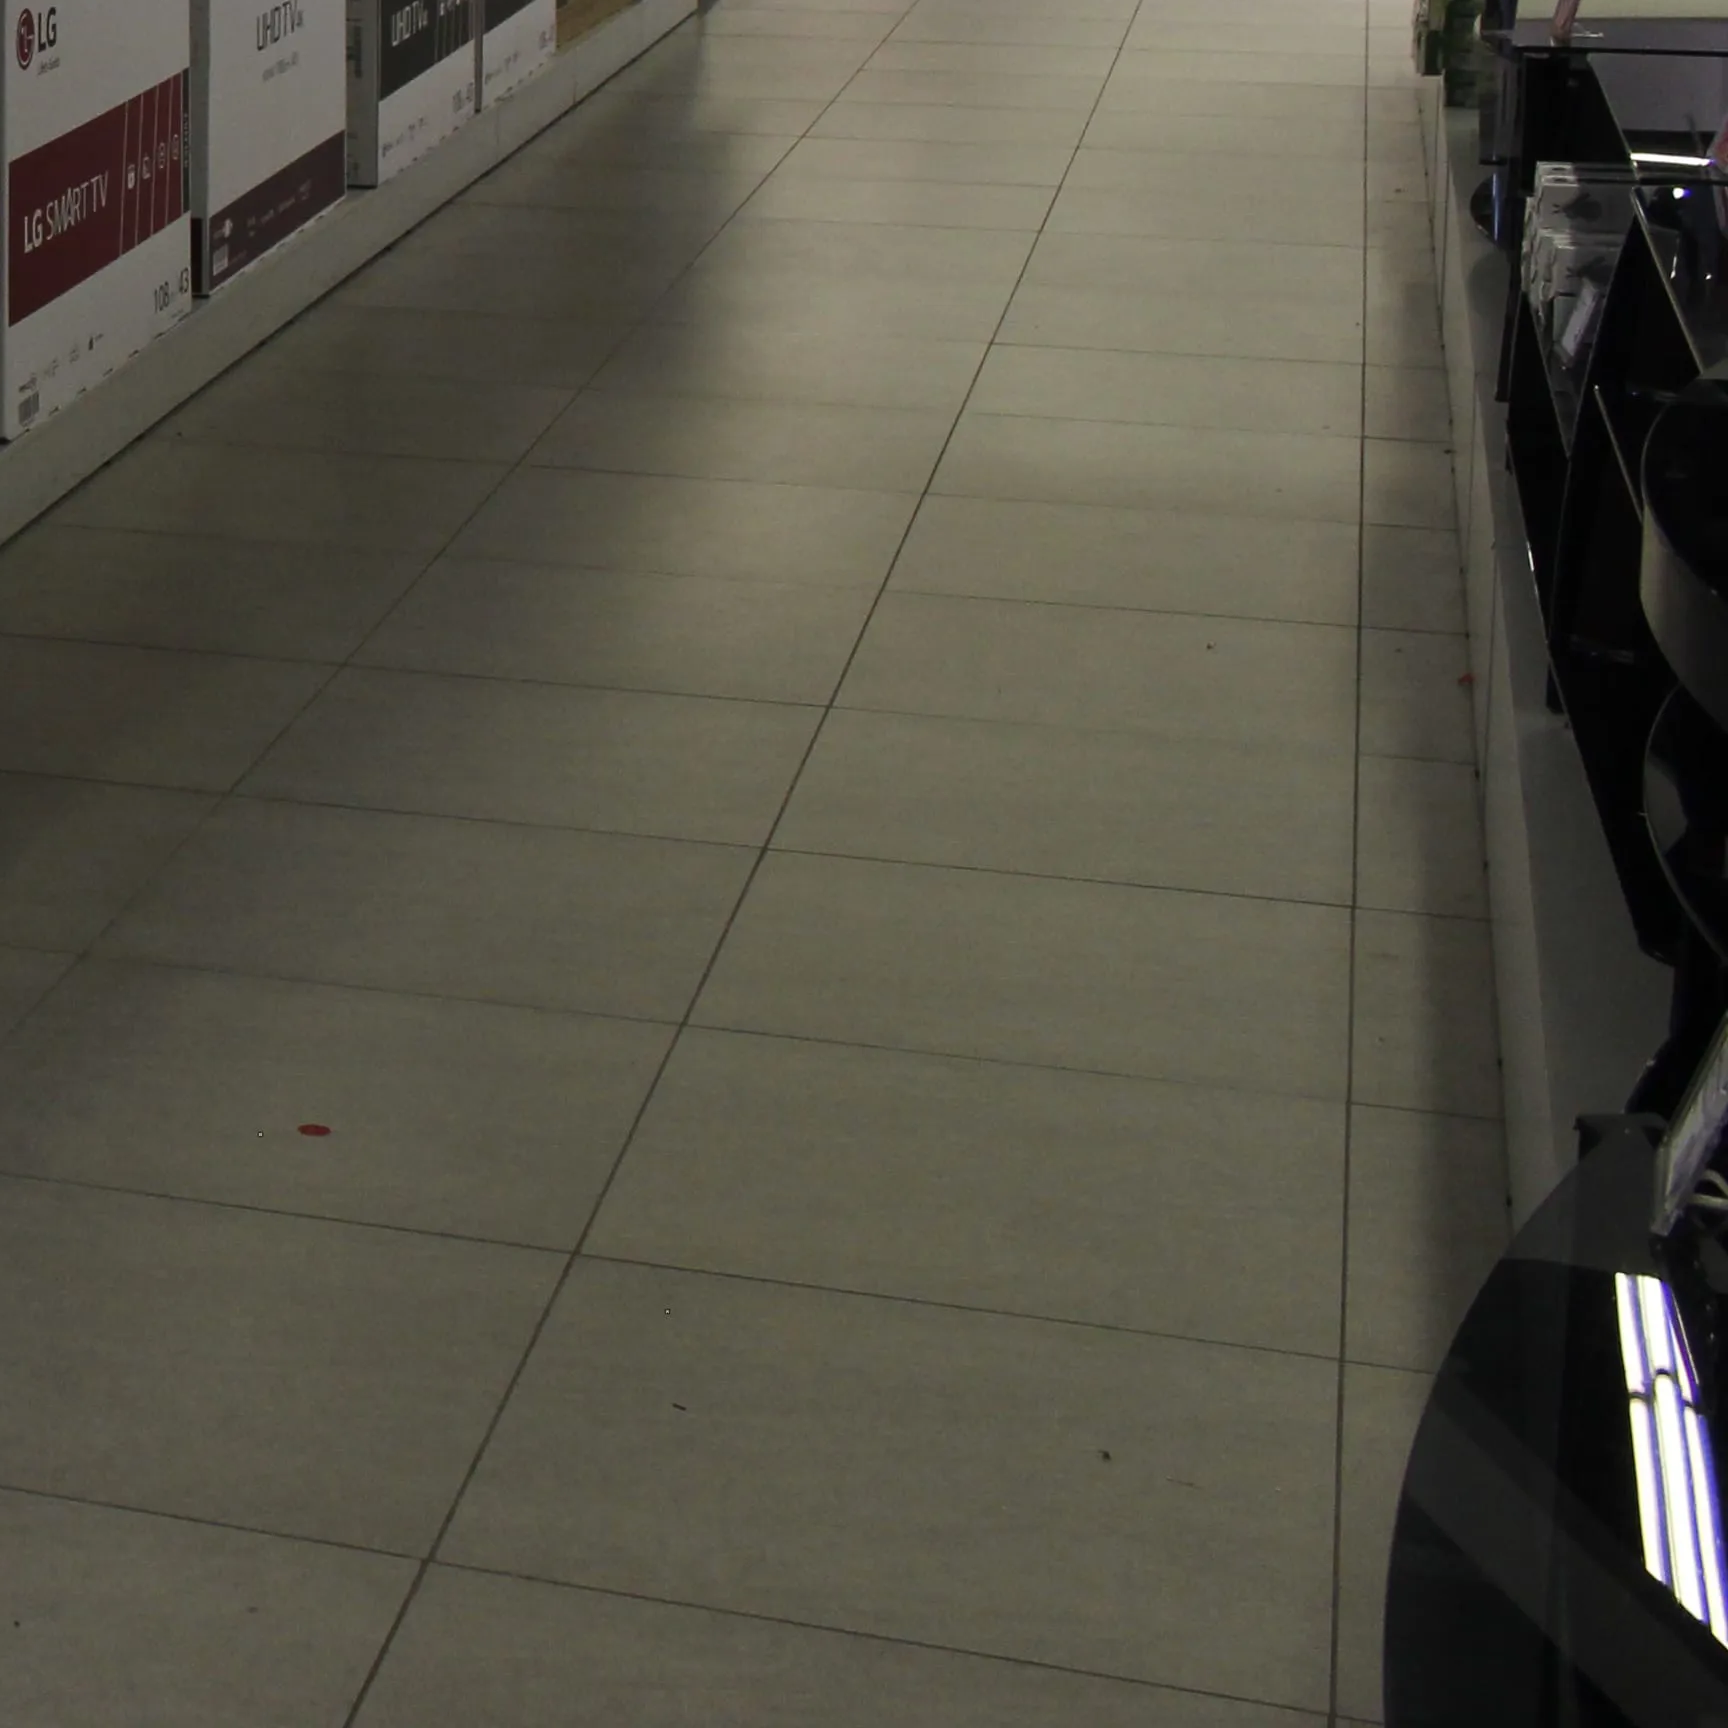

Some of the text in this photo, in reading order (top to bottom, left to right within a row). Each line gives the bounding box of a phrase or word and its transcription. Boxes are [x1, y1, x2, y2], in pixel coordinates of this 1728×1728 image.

[37, 7, 57, 53] LG
[23, 171, 109, 254] LG SMART TV
